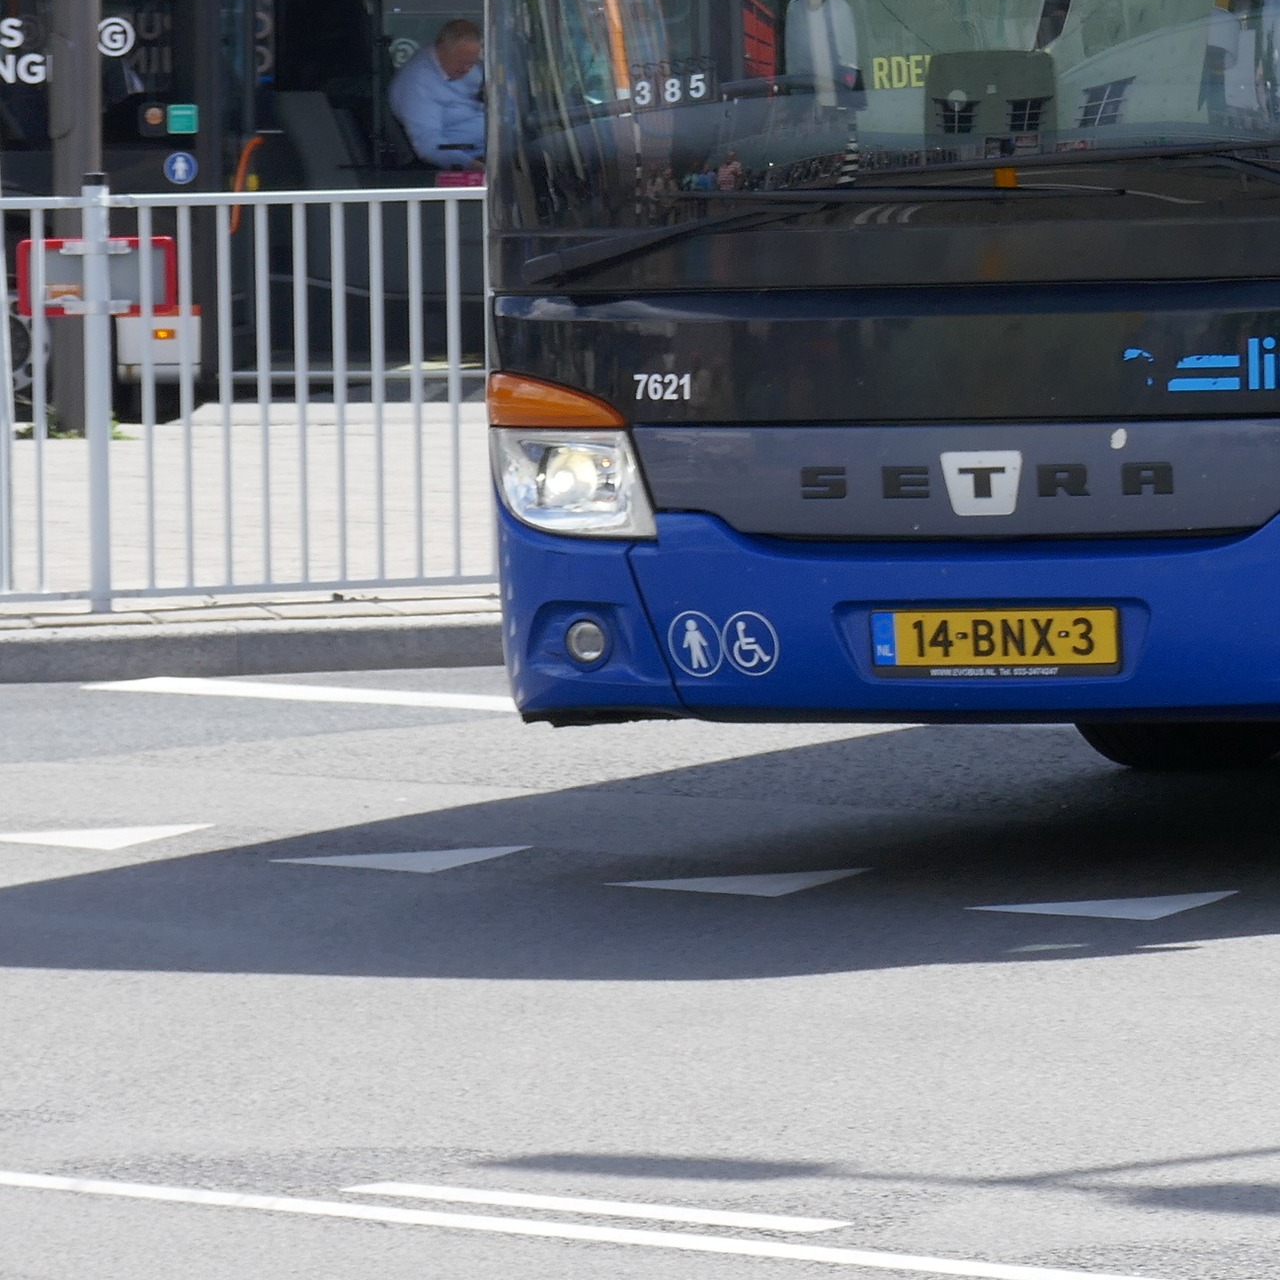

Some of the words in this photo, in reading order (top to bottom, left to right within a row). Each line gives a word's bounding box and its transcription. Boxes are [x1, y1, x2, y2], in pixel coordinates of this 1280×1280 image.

[873, 55, 932, 89] RDE
[633, 373, 691, 400] 7621
[801, 461, 1174, 500] SETRA
[876, 645, 894, 658] NL
[912, 617, 1095, 658] 14-BNX-3
